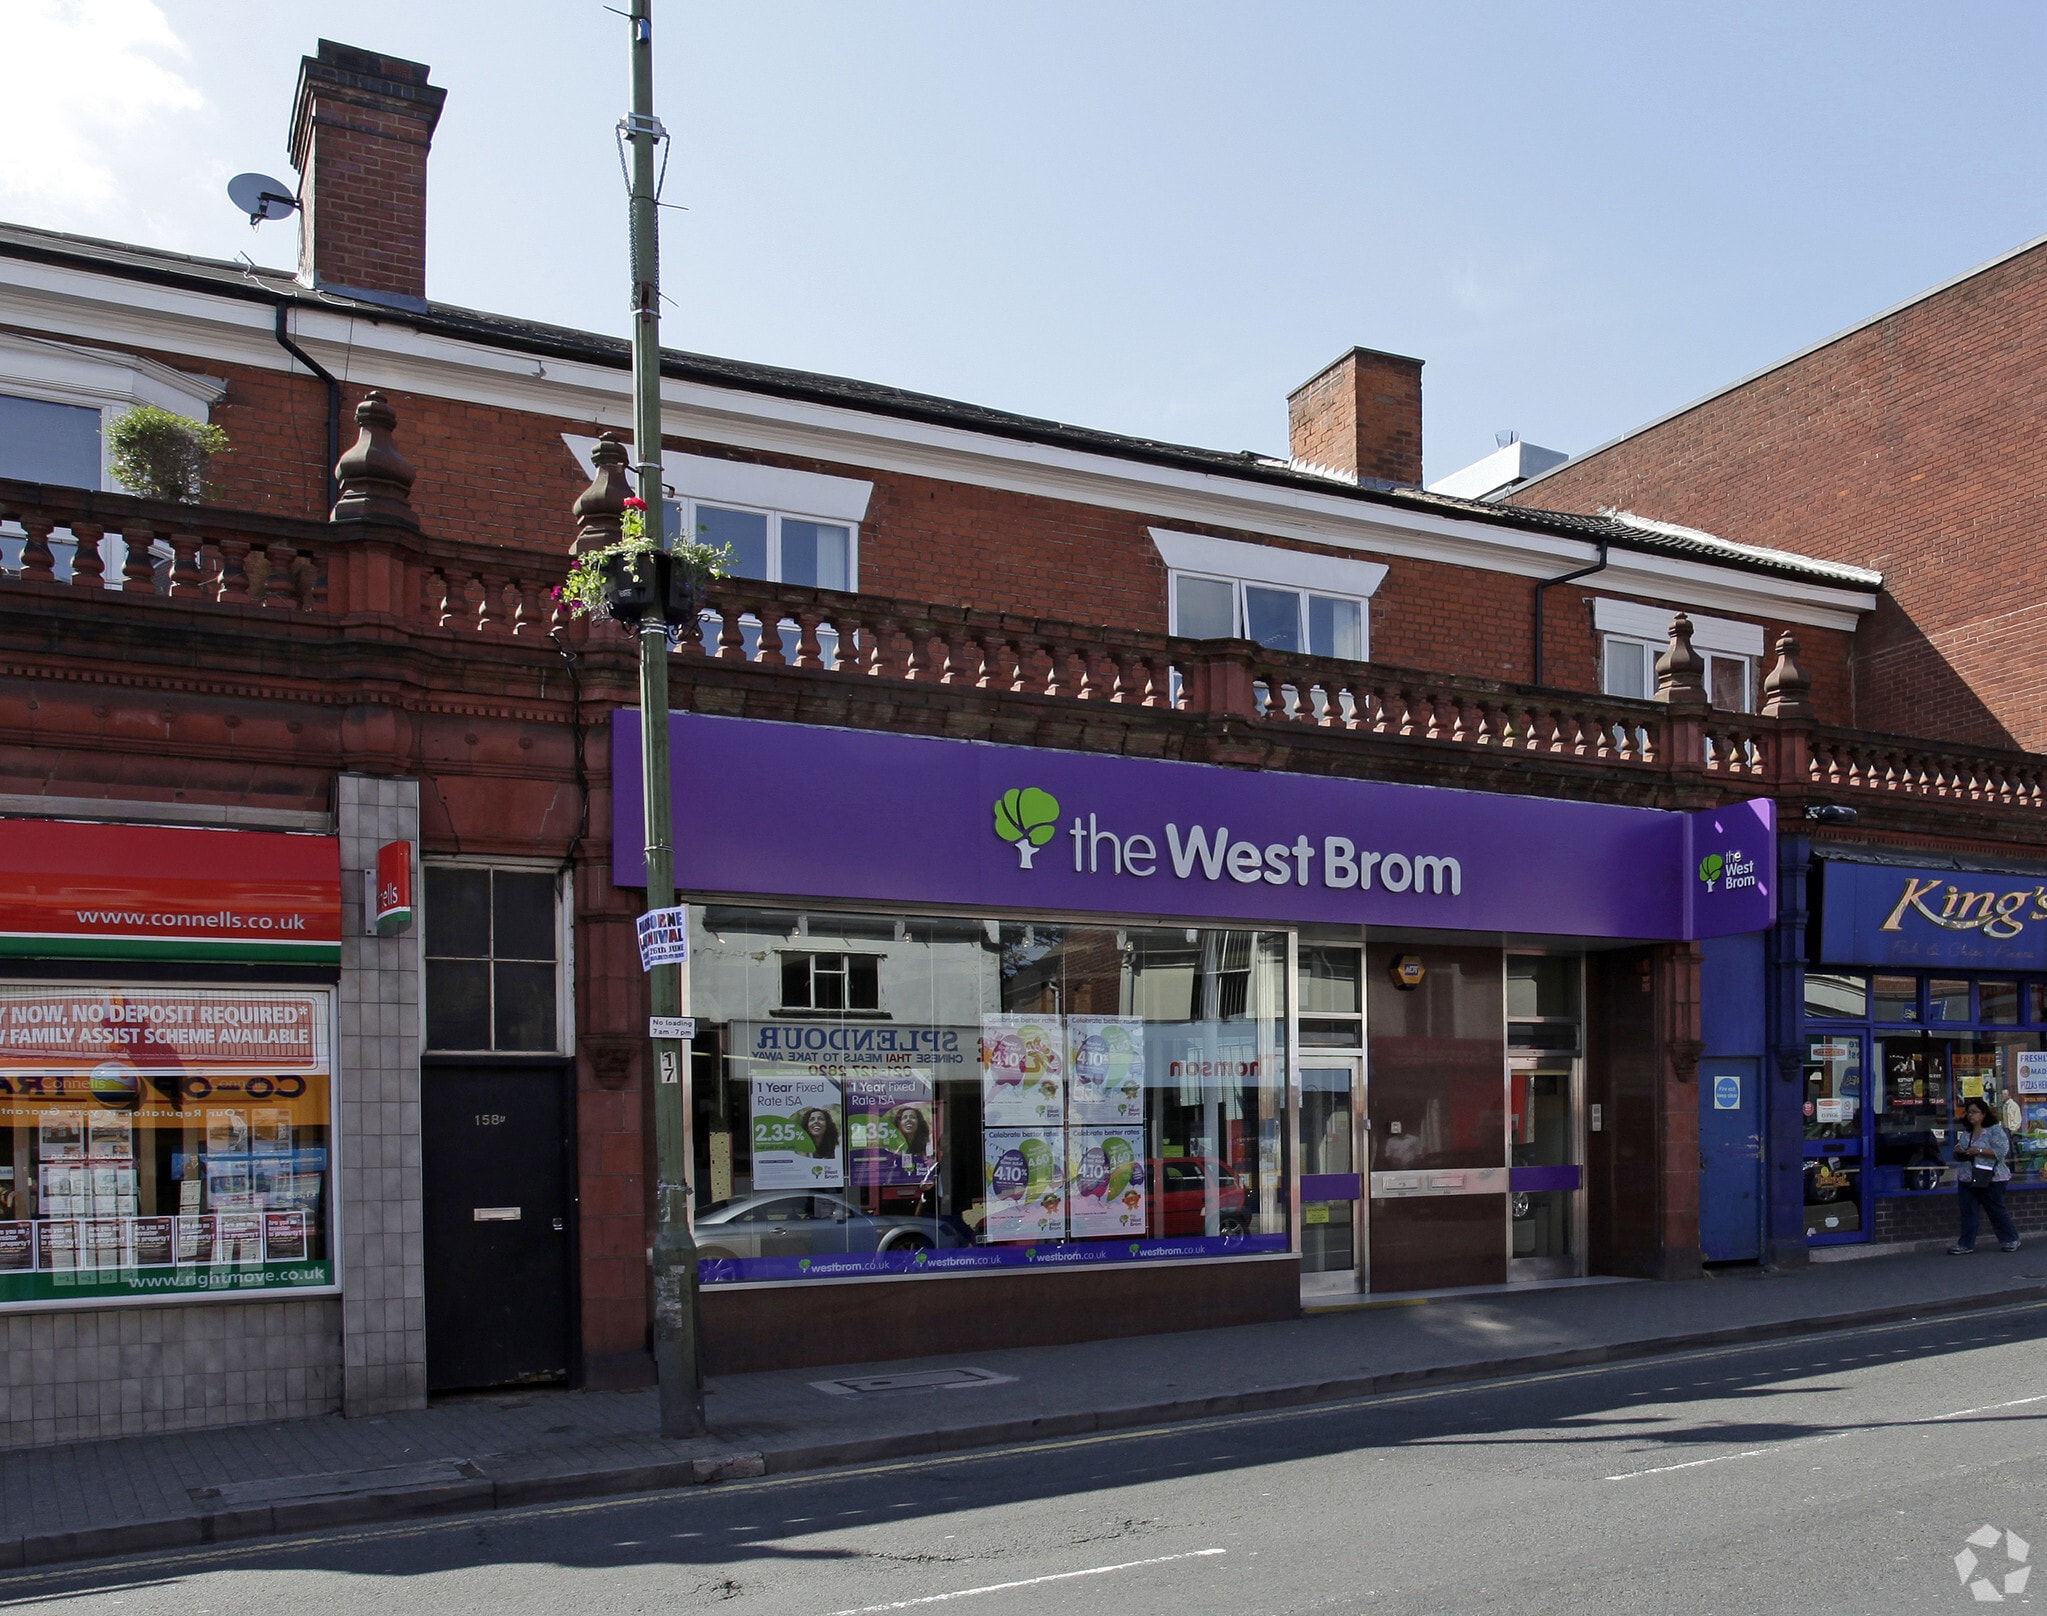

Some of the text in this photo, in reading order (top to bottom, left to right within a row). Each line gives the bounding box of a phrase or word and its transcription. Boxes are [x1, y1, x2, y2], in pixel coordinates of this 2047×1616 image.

[1069, 811, 1462, 897] the West Brom
[1725, 850, 1742, 863] the
[1725, 860, 1755, 877] West
[1725, 875, 1756, 890] Brom
[1879, 877, 2047, 939] King's
[75, 910, 306, 930] www.connells.co.uk
[1405, 965, 1418, 974] ADT
[11, 1005, 67, 1025] NOW,
[72, 1004, 104, 1023] NO
[109, 1004, 195, 1024] DEPOSIT
[1071, 1015, 1103, 1024] Celebrate
[665, 1019, 693, 1028] loading
[10, 1027, 75, 1044] FAMILY
[78, 1027, 140, 1044] ASSIST
[144, 1028, 215, 1044] SCHEME
[218, 1028, 309, 1044] AVAILABLE
[757, 1081, 825, 1093] 1 Year Fixed
[860, 1081, 886, 1093] Year
[888, 1080, 916, 1092] Fixed
[757, 1095, 803, 1106] Rate ISA
[851, 1094, 896, 1106] Rate ISA
[755, 1123, 805, 1142] 2.35%
[988, 1131, 1020, 1139] Celebrate
[1021, 1130, 1042, 1138] better
[1072, 1130, 1103, 1138] Celebrate
[1104, 1129, 1124, 1137] better
[994, 1166, 1028, 1182] 4.10%
[1078, 1163, 1110, 1179] 4.10%
[1036, 1250, 1107, 1262] westbrom.co.uk
[1139, 1245, 1206, 1257] westbrom.co.uk
[811, 1260, 890, 1273] westbrom.co.uk
[927, 1255, 1001, 1267] westbrom.co.uk
[129, 1266, 325, 1288] www.rightmove.co.uk
